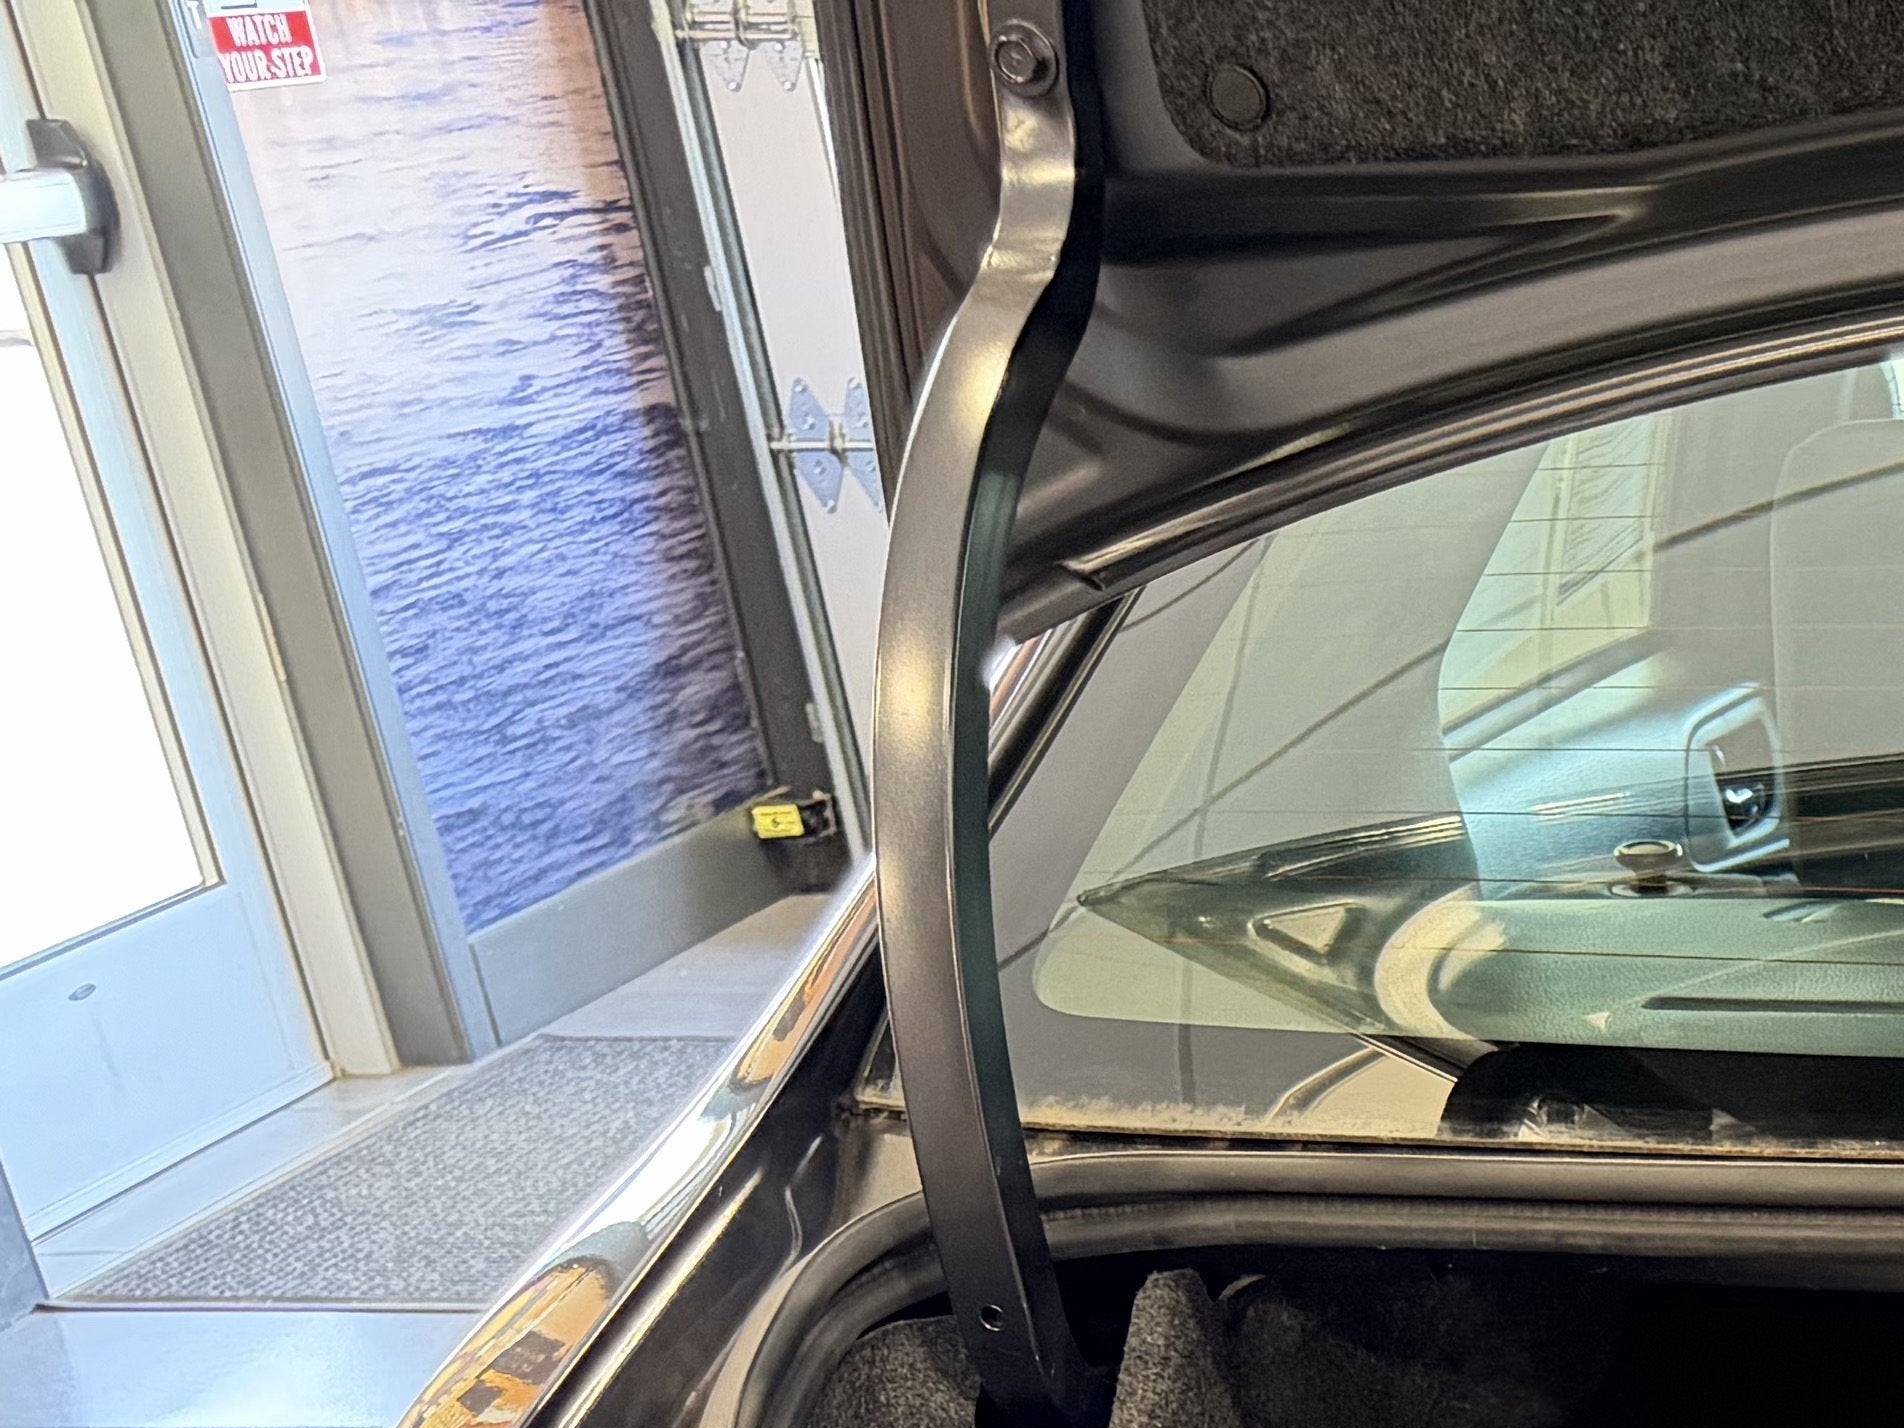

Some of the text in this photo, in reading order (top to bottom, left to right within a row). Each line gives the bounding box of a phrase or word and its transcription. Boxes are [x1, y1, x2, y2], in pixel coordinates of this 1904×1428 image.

[226, 14, 292, 47] WATCH
[219, 45, 313, 83] YOUR STEP
